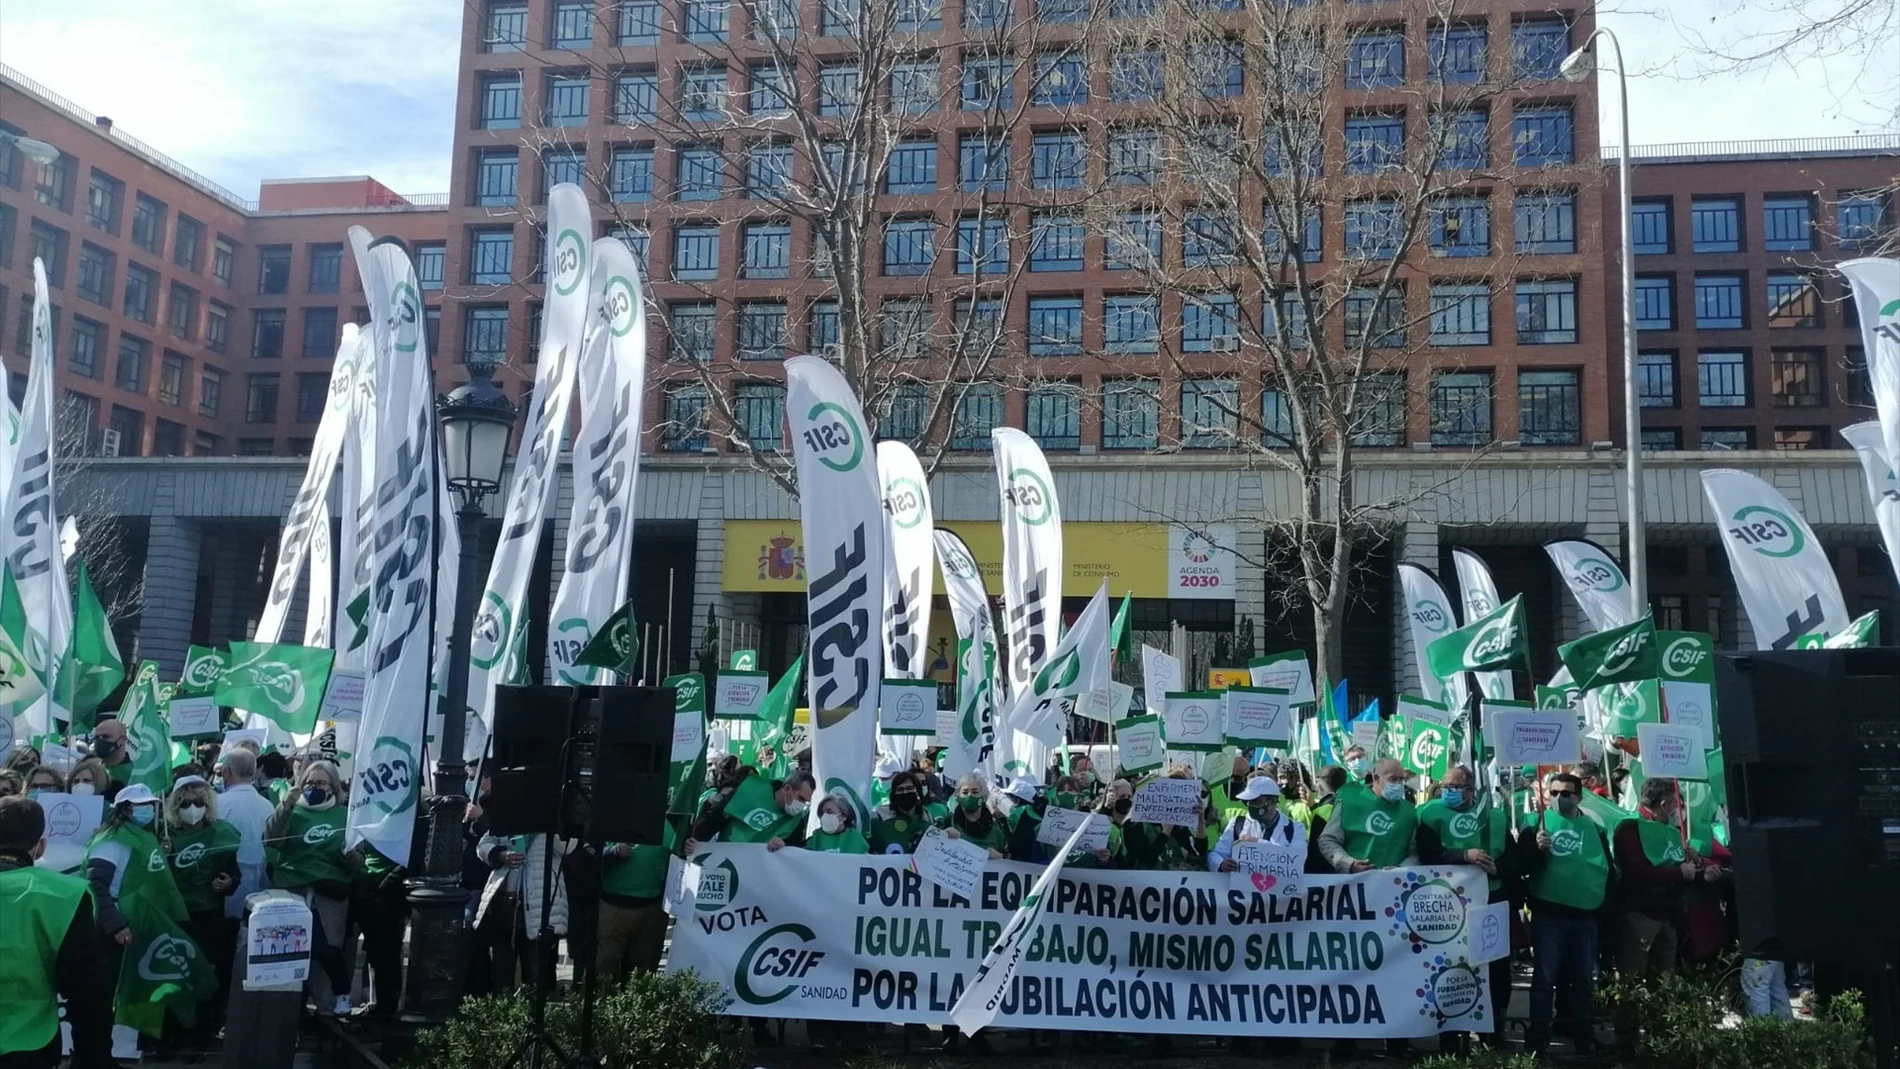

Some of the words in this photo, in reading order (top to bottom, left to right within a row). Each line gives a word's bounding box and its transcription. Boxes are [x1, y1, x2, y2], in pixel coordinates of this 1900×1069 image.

[1180, 576, 1219, 587] 2030
[1136, 793, 1196, 805] MALTRATADA
[1238, 845, 1299, 865] ATENCIÓN
[858, 866, 921, 908] POR
[982, 871, 1217, 926] EQIPARACIÓN
[1227, 883, 1376, 926] SALARIAL
[1413, 901, 1455, 914] BRECHA
[698, 905, 768, 935] VOTA
[1410, 914, 1446, 923] SALARIAL
[1417, 923, 1457, 932] SANIDAD
[854, 915, 951, 959] IGUAL
[962, 919, 1117, 974] TRBAJO,
[1128, 931, 1235, 972] MISMO
[1245, 931, 1384, 972] SALARIO
[801, 985, 848, 1001] SANIDAD
[852, 967, 918, 1011] POR
[1000, 970, 1176, 1020] UBILACIÓN
[1186, 983, 1387, 1026] ANTICIPADA
[1442, 998, 1472, 1009] SANIDAD
